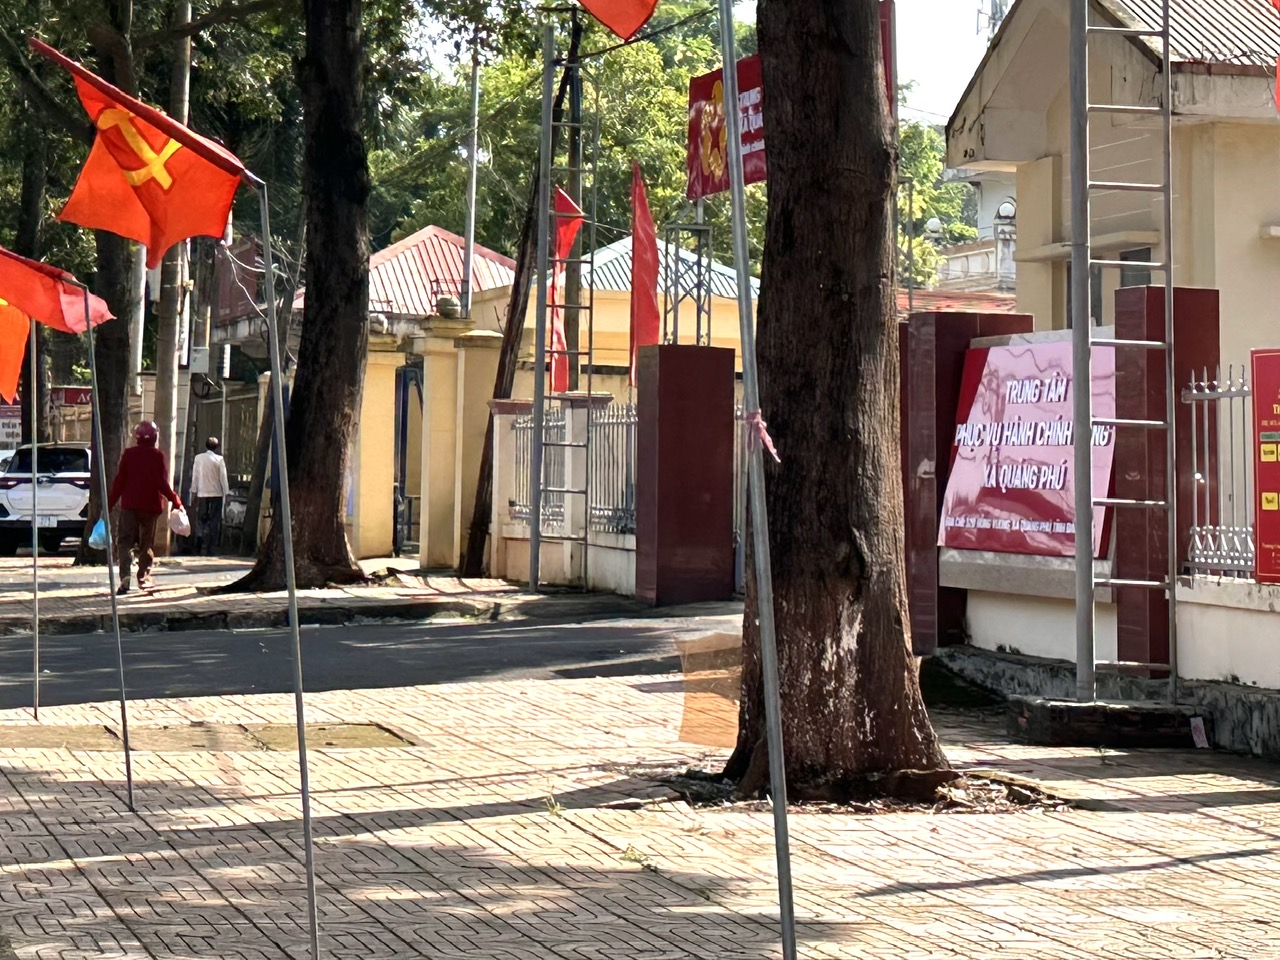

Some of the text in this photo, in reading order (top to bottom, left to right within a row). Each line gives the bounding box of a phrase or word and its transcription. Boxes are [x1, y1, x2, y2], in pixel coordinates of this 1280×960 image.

[1005, 372, 1068, 404] TRUNG TÂM
[954, 423, 984, 452] PHỤC
[1003, 416, 1035, 446] HÀNH
[1036, 415, 1074, 446] CHÍNH
[998, 459, 1037, 493] QUẢNG
[1038, 460, 1068, 489] PHÚ
